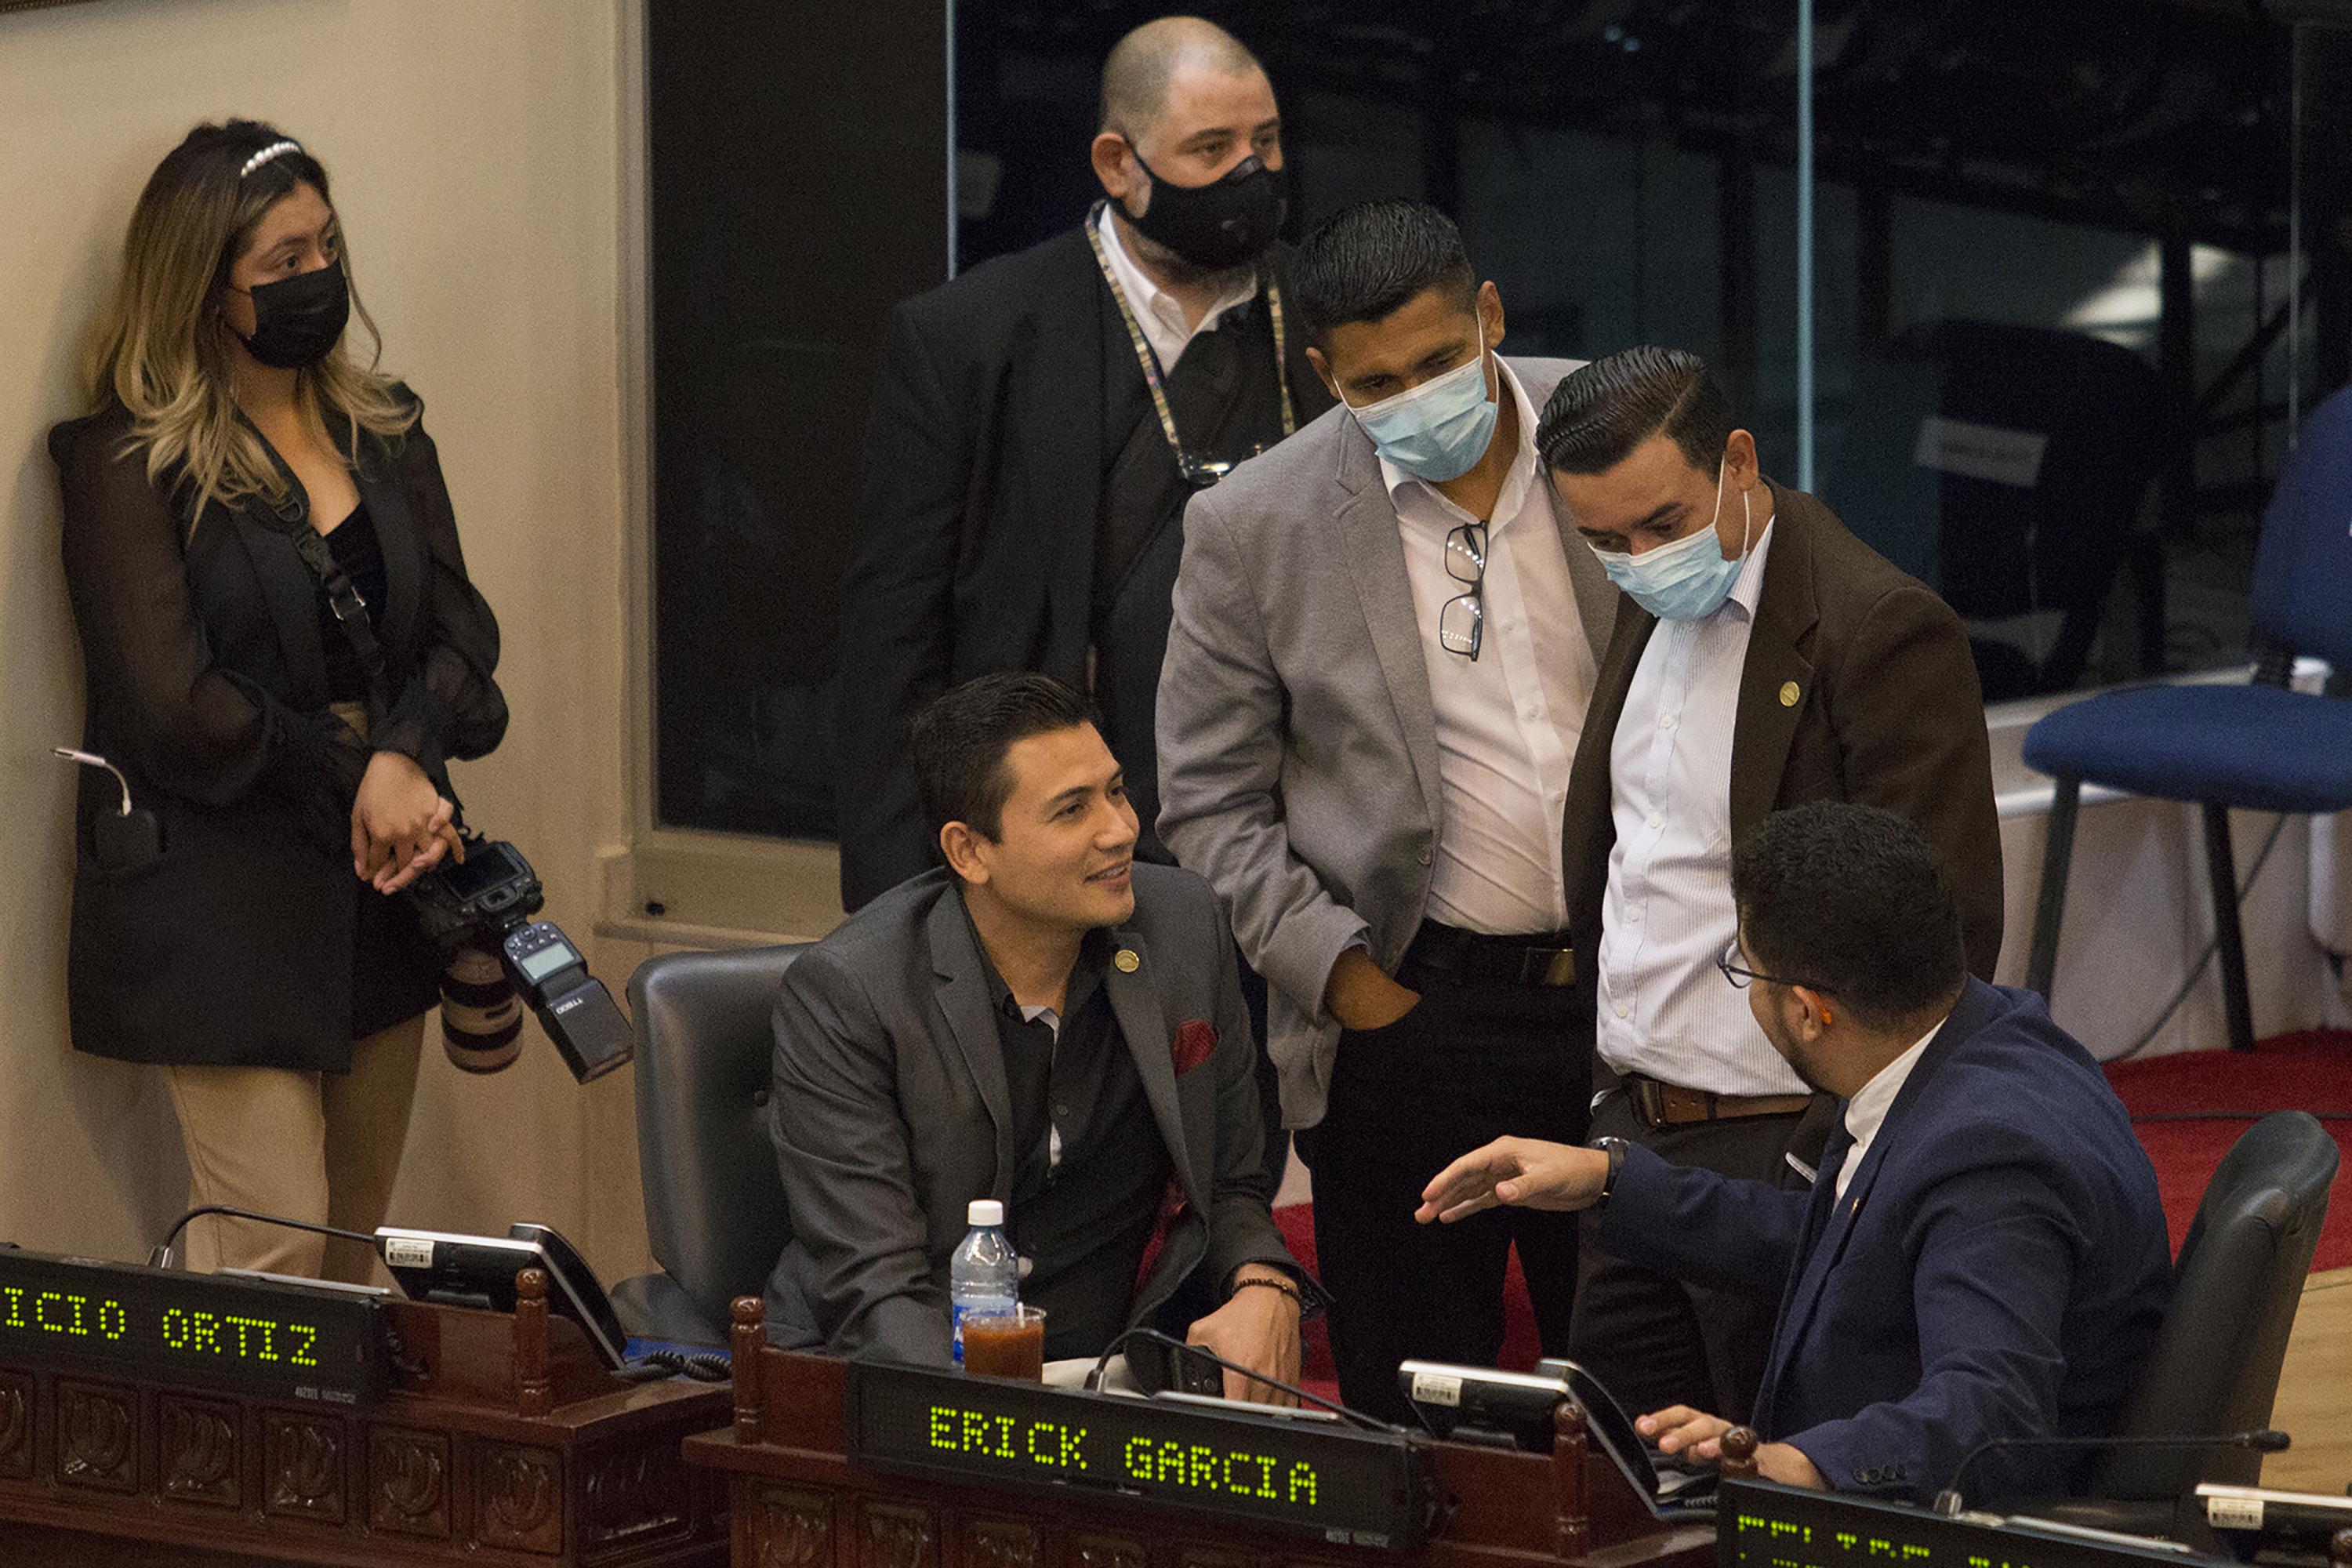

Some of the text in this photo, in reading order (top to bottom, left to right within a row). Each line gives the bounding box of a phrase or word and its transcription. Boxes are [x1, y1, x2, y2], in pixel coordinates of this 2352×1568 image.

[4, 1287, 318, 1368] ICIO ORTIZ
[931, 1406, 1318, 1507] ERICK GARCIA
